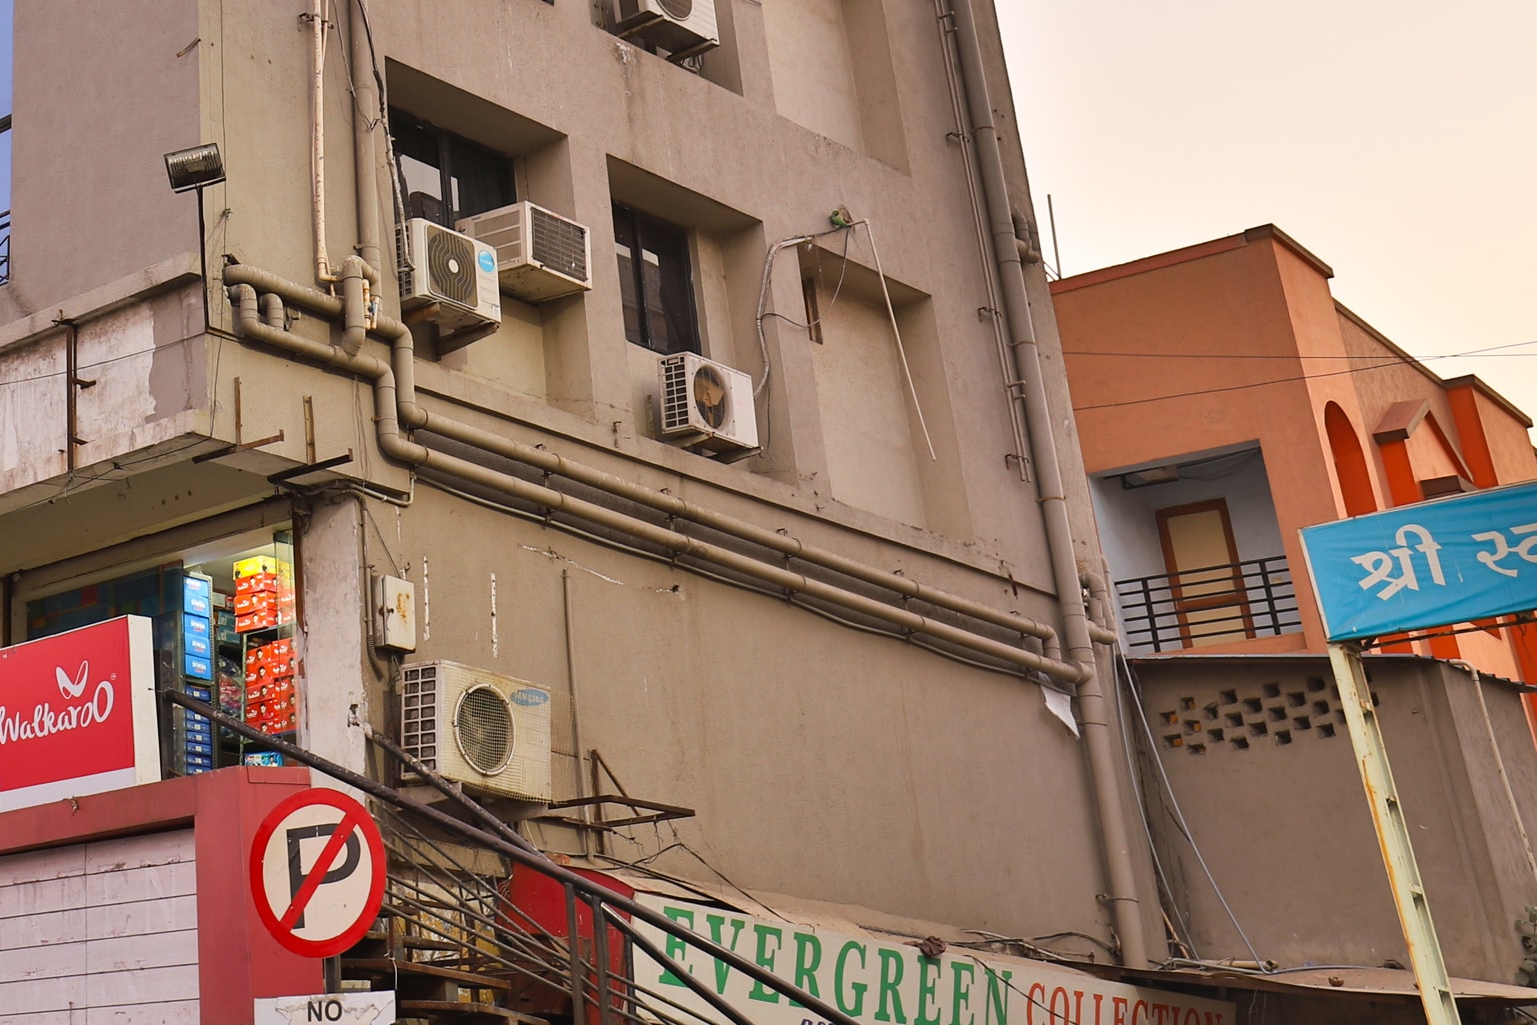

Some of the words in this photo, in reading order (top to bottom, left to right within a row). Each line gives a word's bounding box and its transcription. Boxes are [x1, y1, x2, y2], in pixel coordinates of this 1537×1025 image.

[1350, 524, 1446, 601] श्री
[287, 823, 360, 930] P
[307, 1000, 343, 1022] NO
[659, 906, 1012, 1025] EVERGREEN
[1026, 982, 1223, 1025] COLLE
